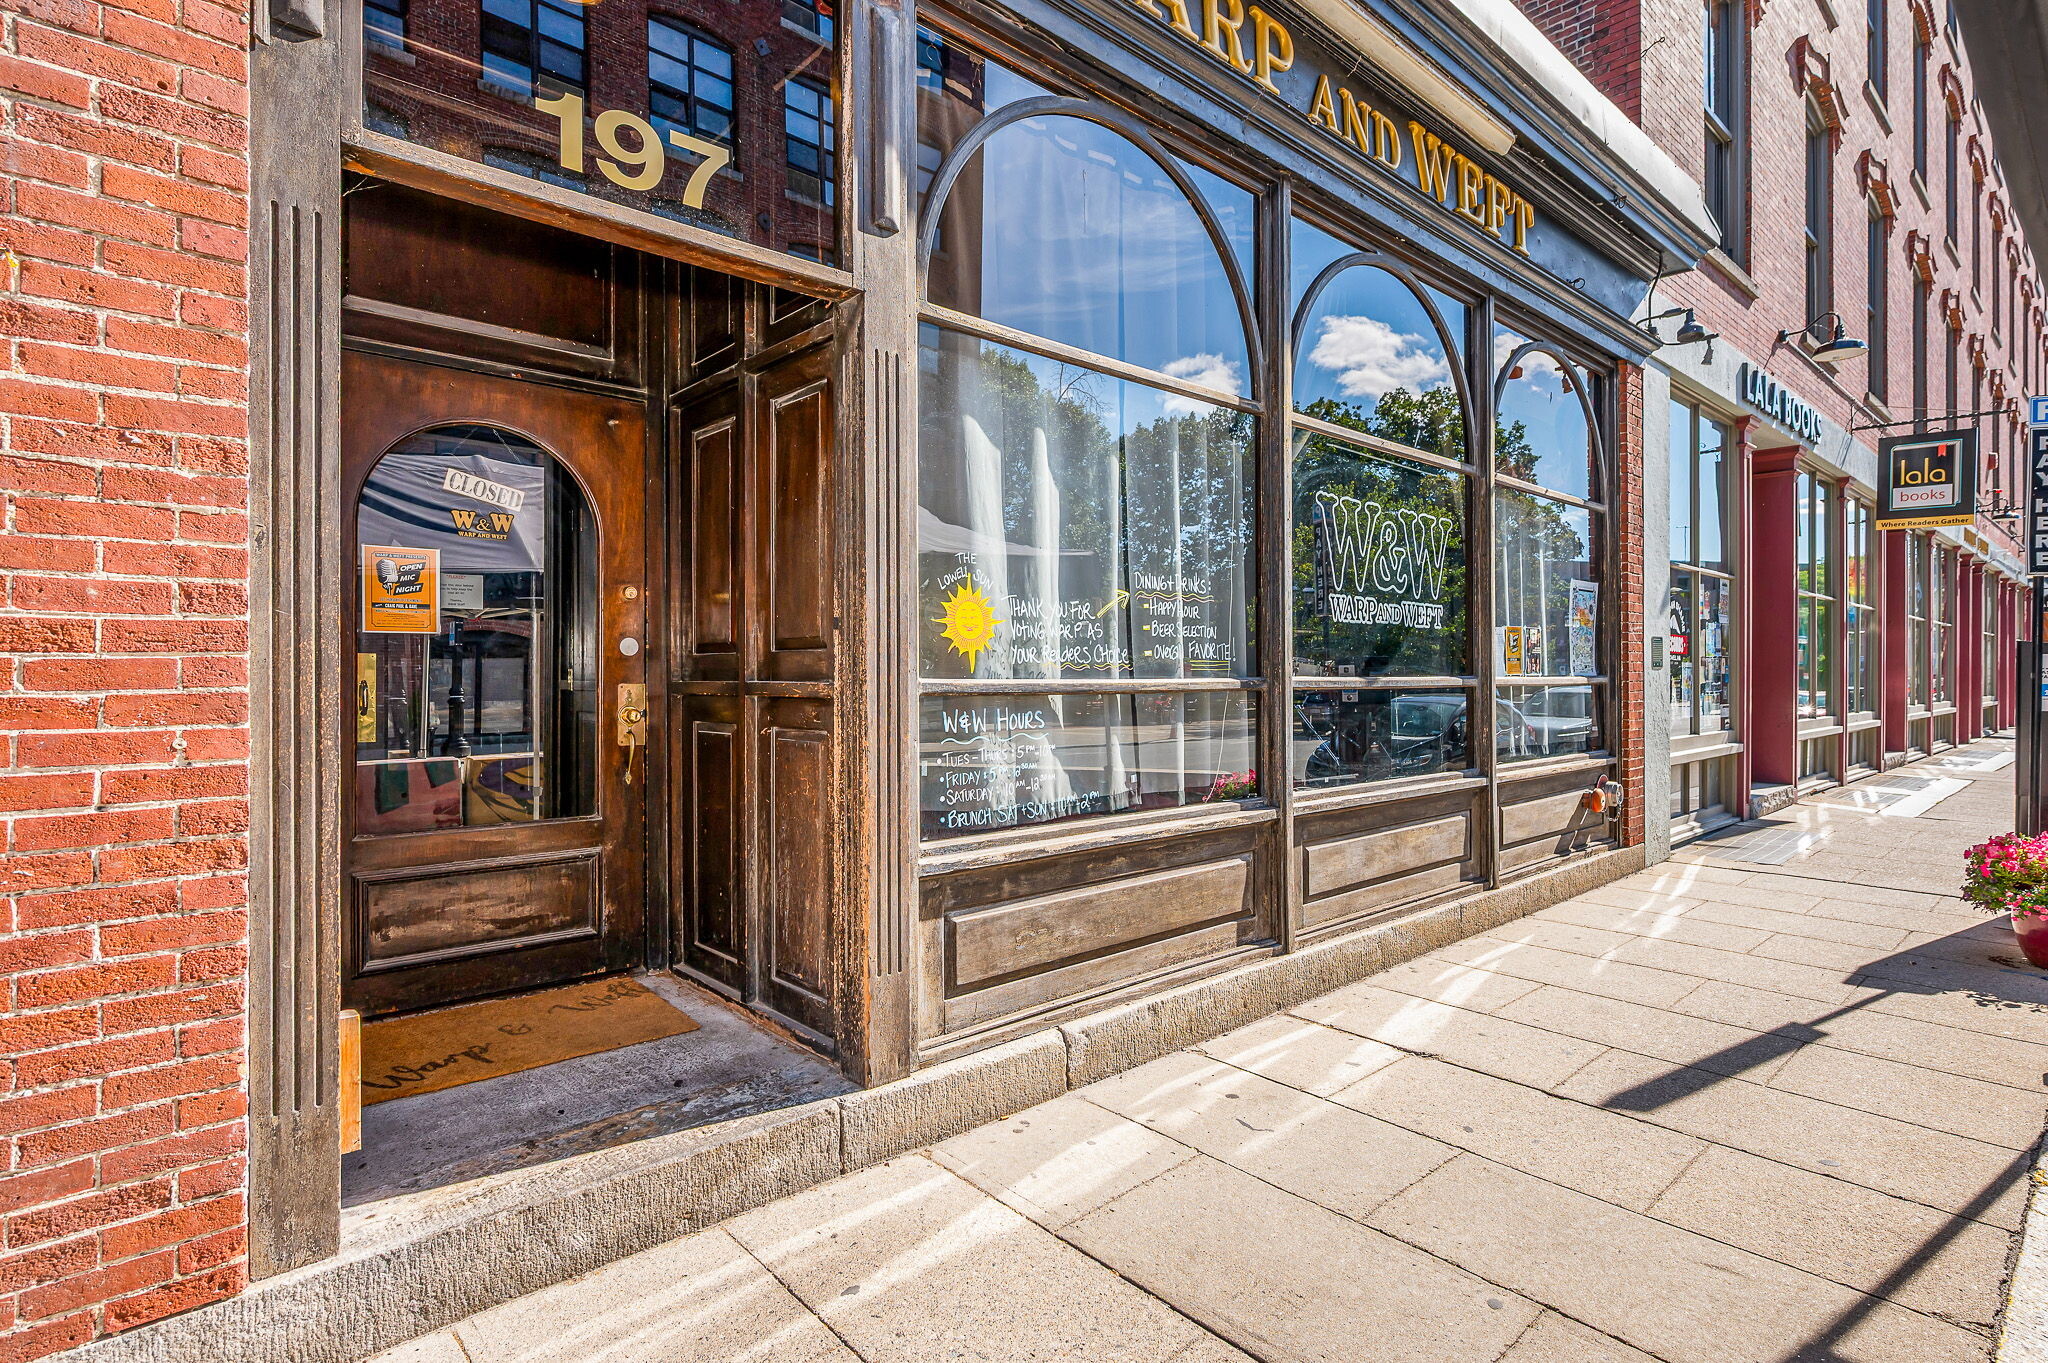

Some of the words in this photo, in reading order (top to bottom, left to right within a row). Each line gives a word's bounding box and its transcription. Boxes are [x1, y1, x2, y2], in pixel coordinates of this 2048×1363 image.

[536, 92, 729, 209] 197
[1308, 74, 1401, 170] AND
[1408, 120, 1536, 257] WEFT
[1900, 457, 1946, 485] lala
[450, 472, 522, 507] CLOSED
[1900, 489, 1946, 502] books
[1881, 520, 1905, 528] Where
[1907, 518, 1939, 526] Readers
[1941, 517, 1969, 525] Gather
[1316, 490, 1453, 600] W&W
[400, 563, 423, 571] OPEN
[955, 552, 977, 564] THE
[396, 584, 421, 593] NIGHT
[400, 574, 416, 582] MIC
[937, 566, 969, 590] LOWELL
[973, 569, 994, 591] SUN
[1001, 594, 1047, 619] THANK
[1070, 601, 1096, 619] FOR
[1150, 597, 1177, 617] HAPPY
[1329, 593, 1377, 624] WARP
[1376, 603, 1402, 625] AND
[1401, 601, 1444, 629] WEFT
[1087, 621, 1103, 640] AS
[1152, 620, 1176, 637] BEER
[1176, 622, 1217, 639] SELECTION
[1011, 644, 1041, 664] YOUR
[943, 708, 987, 733] W&W
[996, 707, 1045, 731] HOURS
[942, 752, 970, 767] TUES
[948, 808, 993, 828] BRUNCH
[997, 804, 1020, 822] SAT
[360, 1042, 494, 1088] Warp
